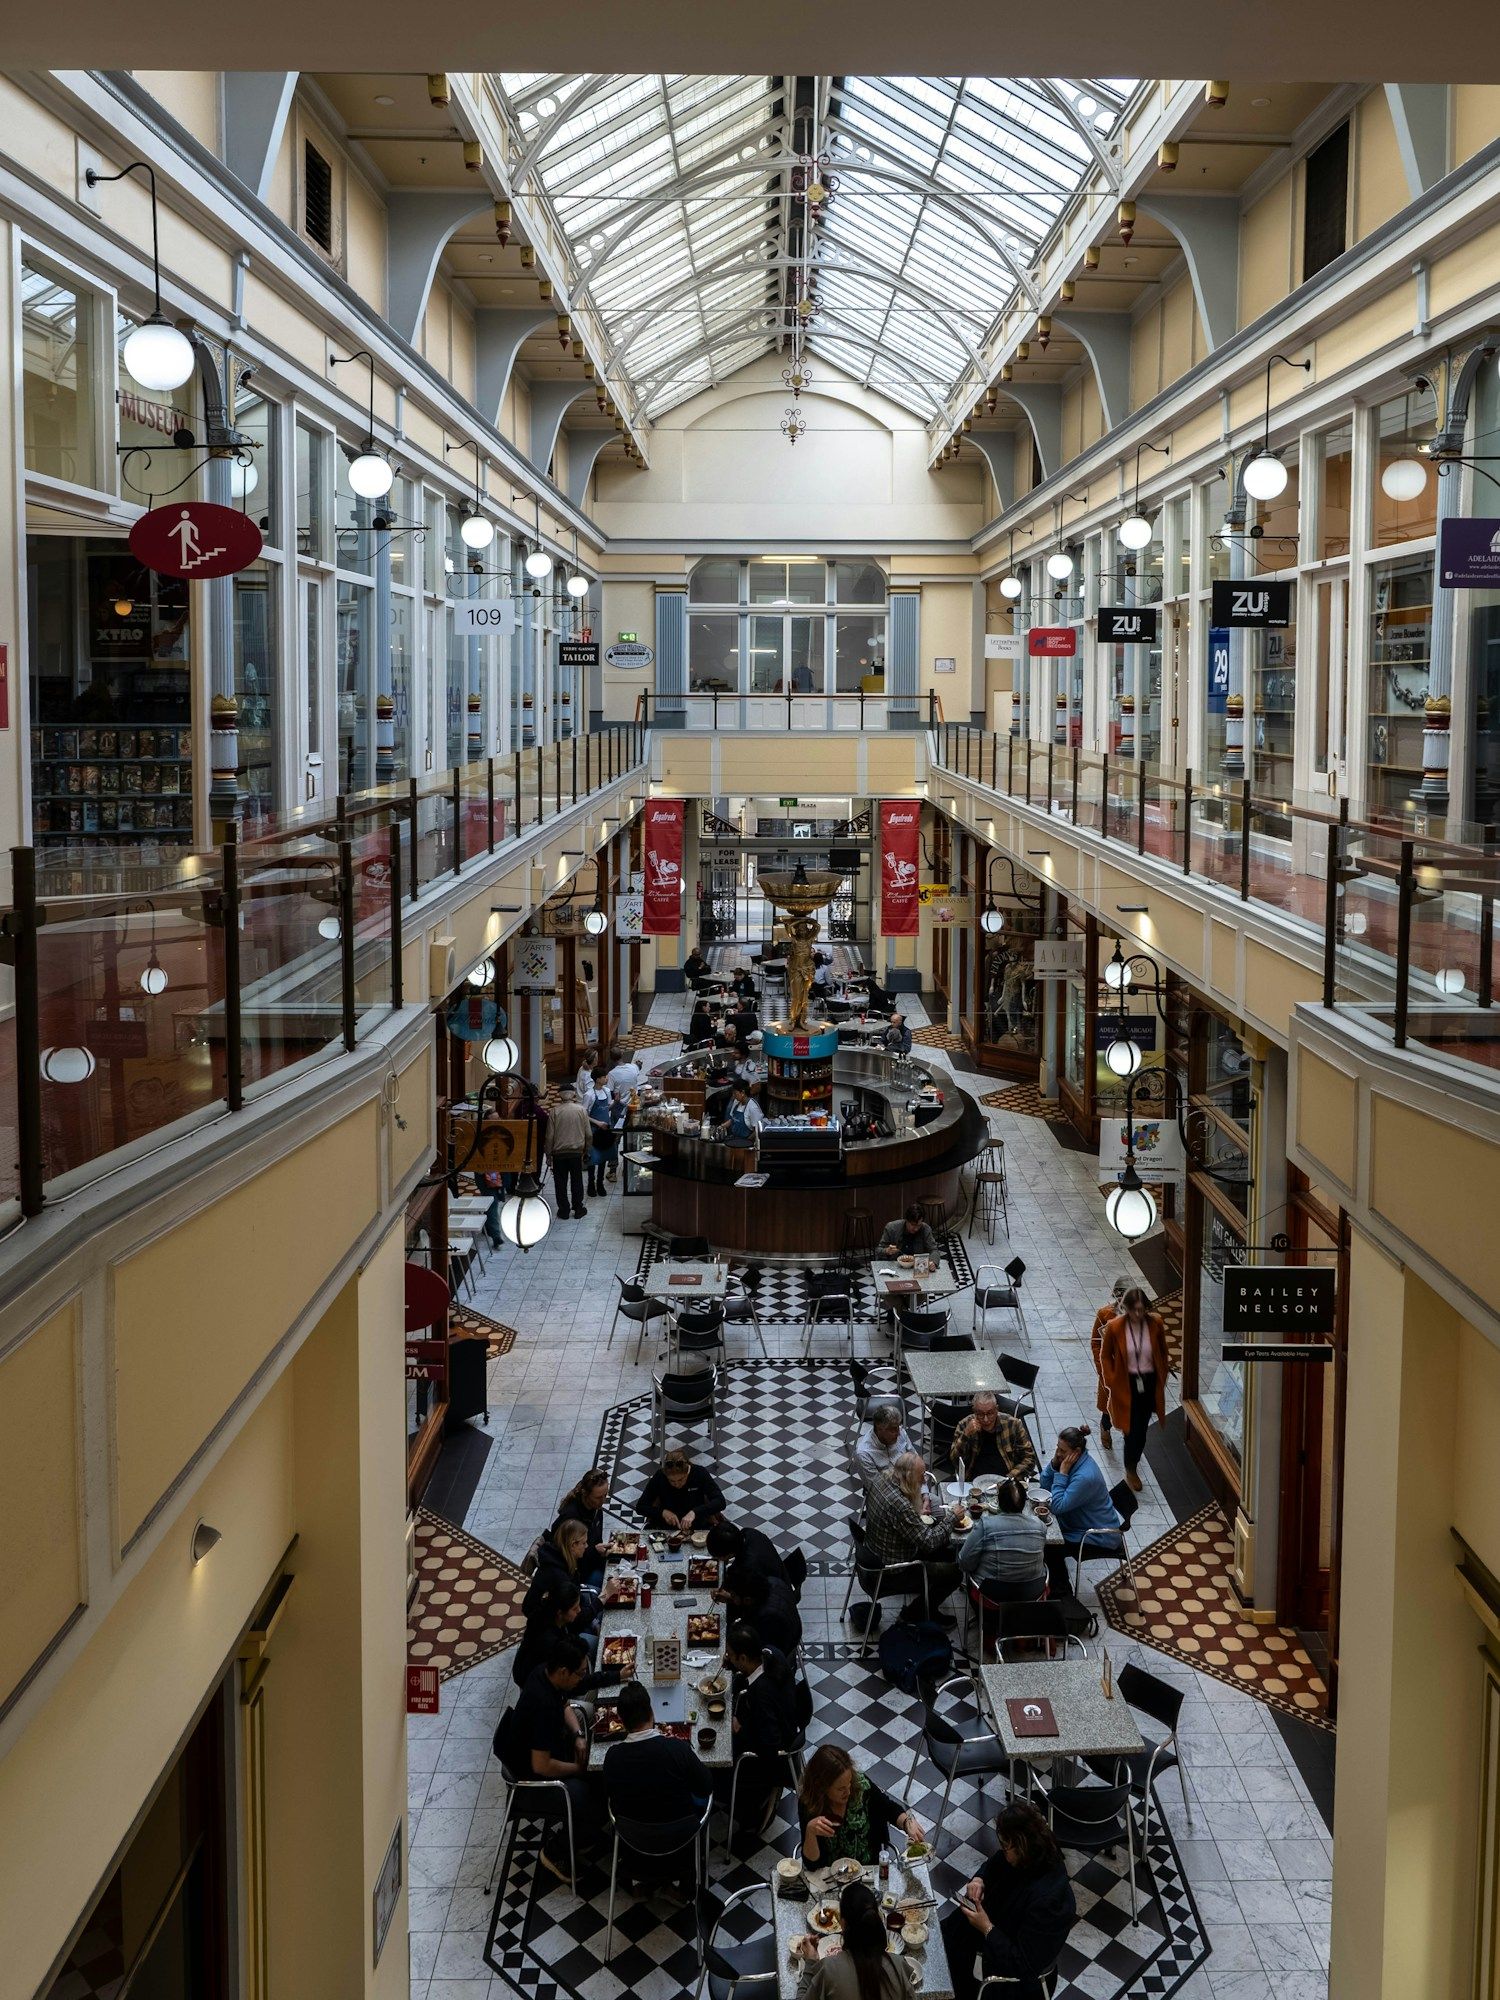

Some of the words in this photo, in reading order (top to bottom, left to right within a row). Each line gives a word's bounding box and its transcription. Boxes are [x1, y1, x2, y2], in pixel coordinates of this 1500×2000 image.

[121, 390, 185, 437] MUSEUM
[1232, 592, 1263, 612] ZU
[467, 608, 501, 626] 109
[1112, 616, 1137, 631] ZU
[97, 629, 143, 641] XTRO
[1269, 636, 1282, 655] ZU
[562, 654, 595, 662] TAILOR
[1214, 649, 1228, 683] 29
[650, 811, 677, 823] Segafredo
[888, 813, 914, 825] Segafredo
[522, 988, 547, 996] Gallery
[1213, 1216, 1224, 1243] ART
[1240, 1287, 1318, 1297] BAILEY
[1239, 1304, 1318, 1314] NELSON
